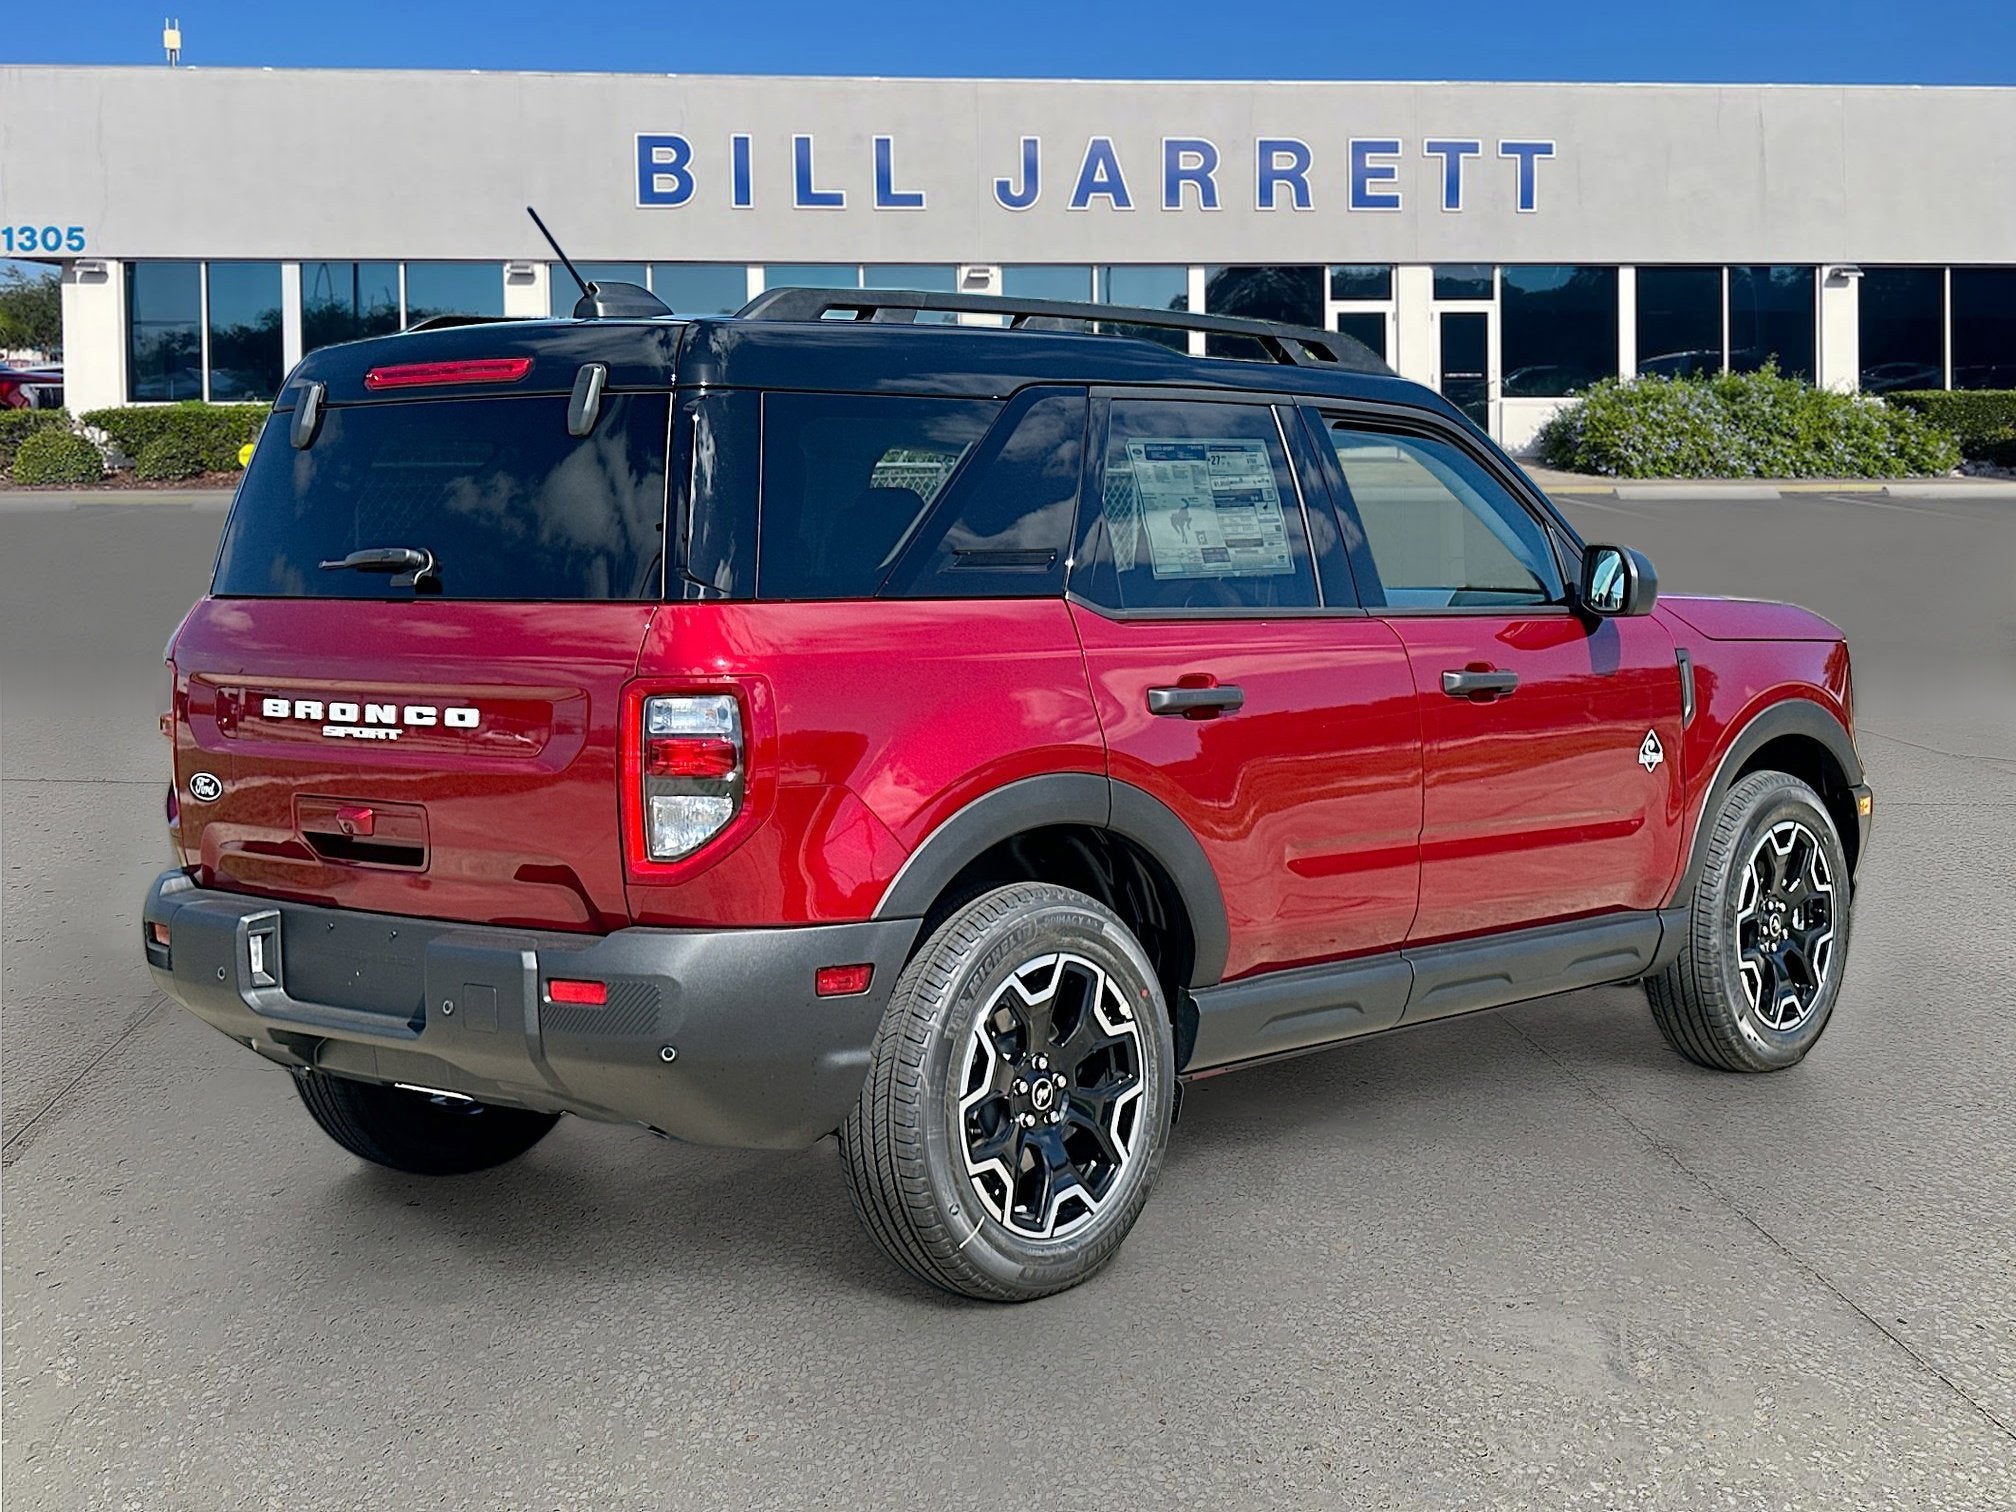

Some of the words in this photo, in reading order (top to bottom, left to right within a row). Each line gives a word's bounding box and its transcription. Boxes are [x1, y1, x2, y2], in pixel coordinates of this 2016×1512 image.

[634, 132, 926, 210] BILL
[993, 135, 1556, 213] JARRETT
[1, 226, 86, 252] 1305
[262, 698, 480, 728] BRONCO
[322, 725, 403, 741] SPORT
[195, 776, 215, 796] Ford
